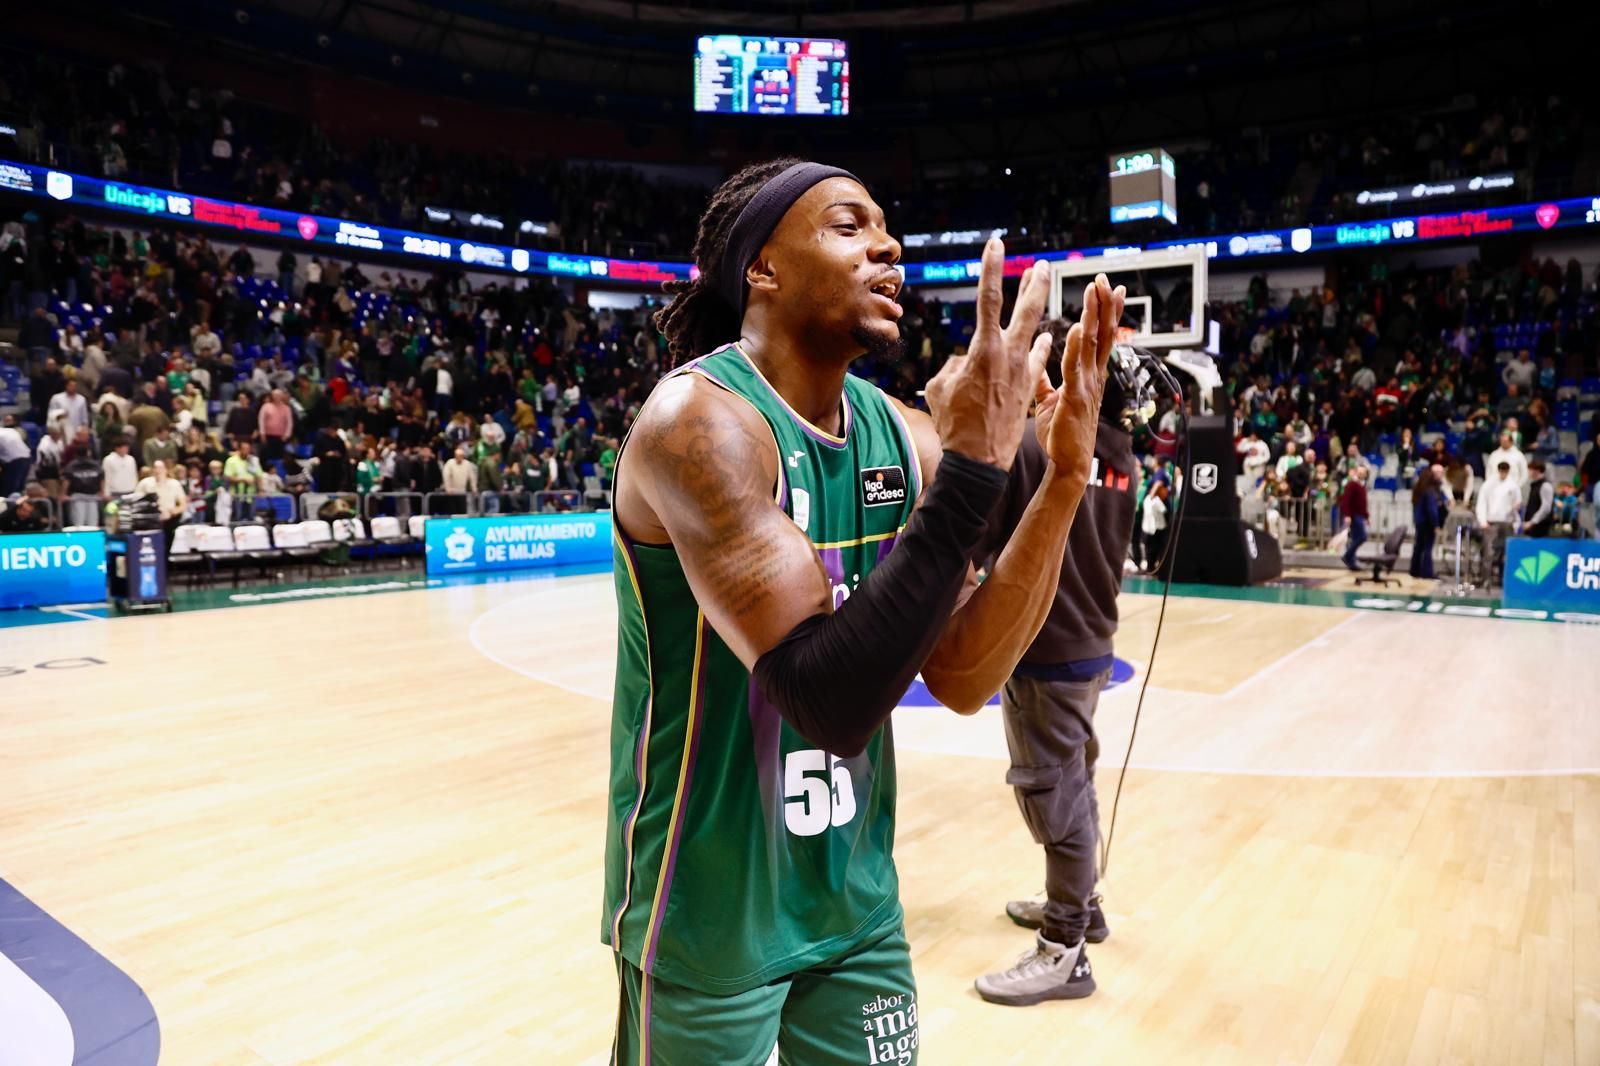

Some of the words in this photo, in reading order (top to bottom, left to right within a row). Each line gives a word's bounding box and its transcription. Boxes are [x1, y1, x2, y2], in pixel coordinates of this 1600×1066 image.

[1116, 154, 1153, 174] 1:00
[104, 184, 166, 213] Unicaja
[167, 195, 191, 215] VS
[1336, 223, 1390, 244] Unicaja
[1392, 219, 1415, 238] VS
[923, 264, 965, 281] Unicaja
[864, 479, 884, 492] liga
[866, 488, 904, 502] endesa
[485, 522, 596, 543] AYUNTAMIENTO
[2, 545, 86, 570] IENTO
[485, 545, 507, 562] DE
[509, 542, 555, 560] MIJAS
[784, 749, 857, 837] 55
[862, 994, 906, 1016] sabor
[863, 1019, 874, 1032] a
[864, 1028, 919, 1066] laga
